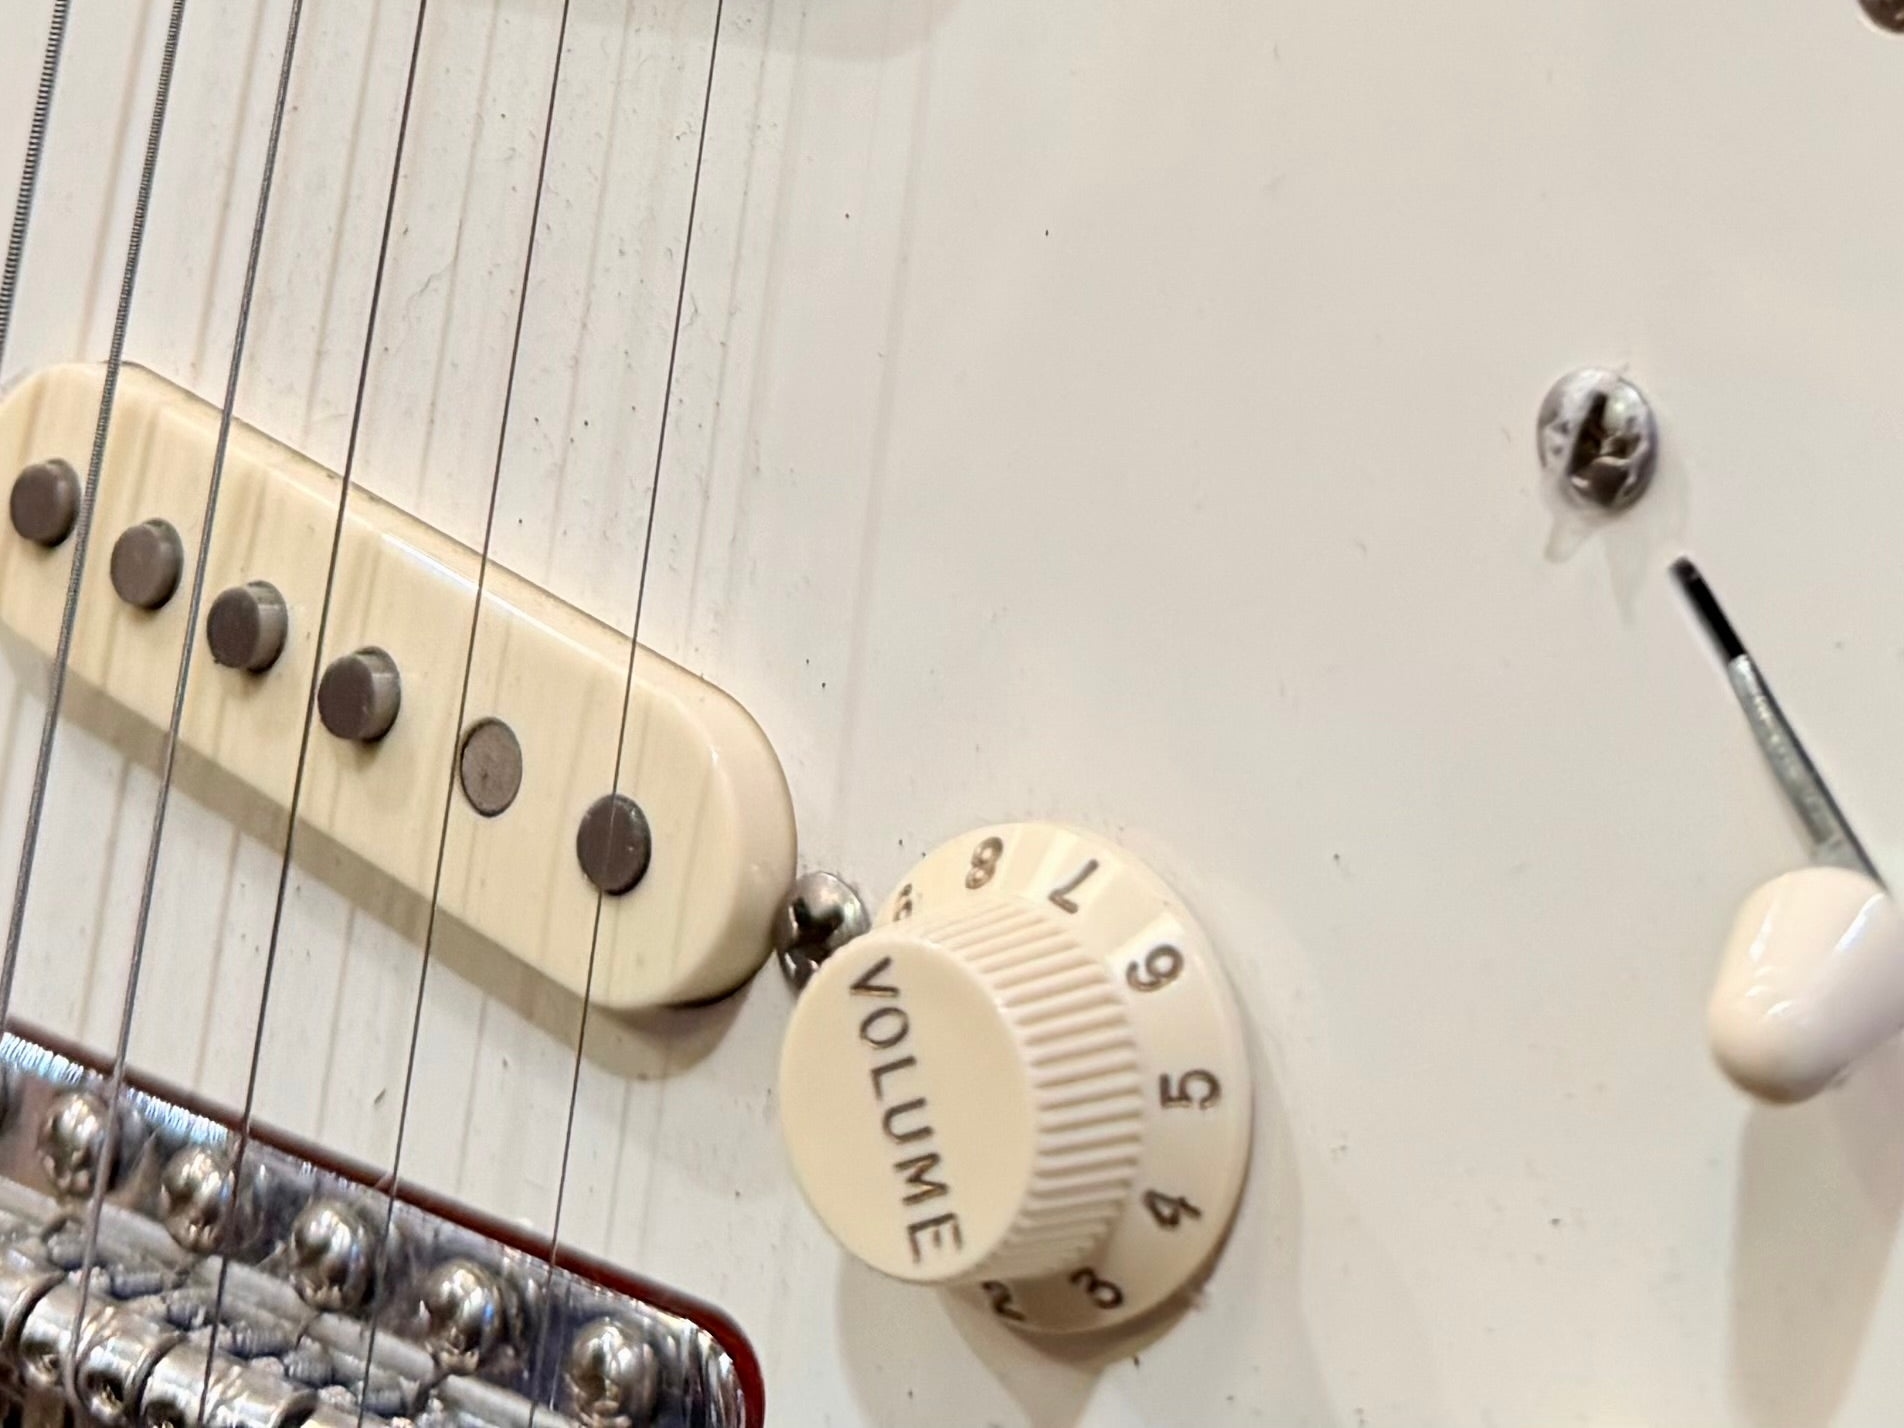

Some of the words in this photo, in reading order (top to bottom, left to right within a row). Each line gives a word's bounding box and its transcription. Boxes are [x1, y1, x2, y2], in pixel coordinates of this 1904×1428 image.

[965, 836, 1004, 890] 8
[1049, 859, 1099, 914] 7
[1126, 943, 1185, 993] 6
[849, 956, 963, 1265] VOLUME
[1160, 1068, 1222, 1110] 5
[1143, 1189, 1201, 1230] 4
[1071, 1267, 1125, 1310] 3
